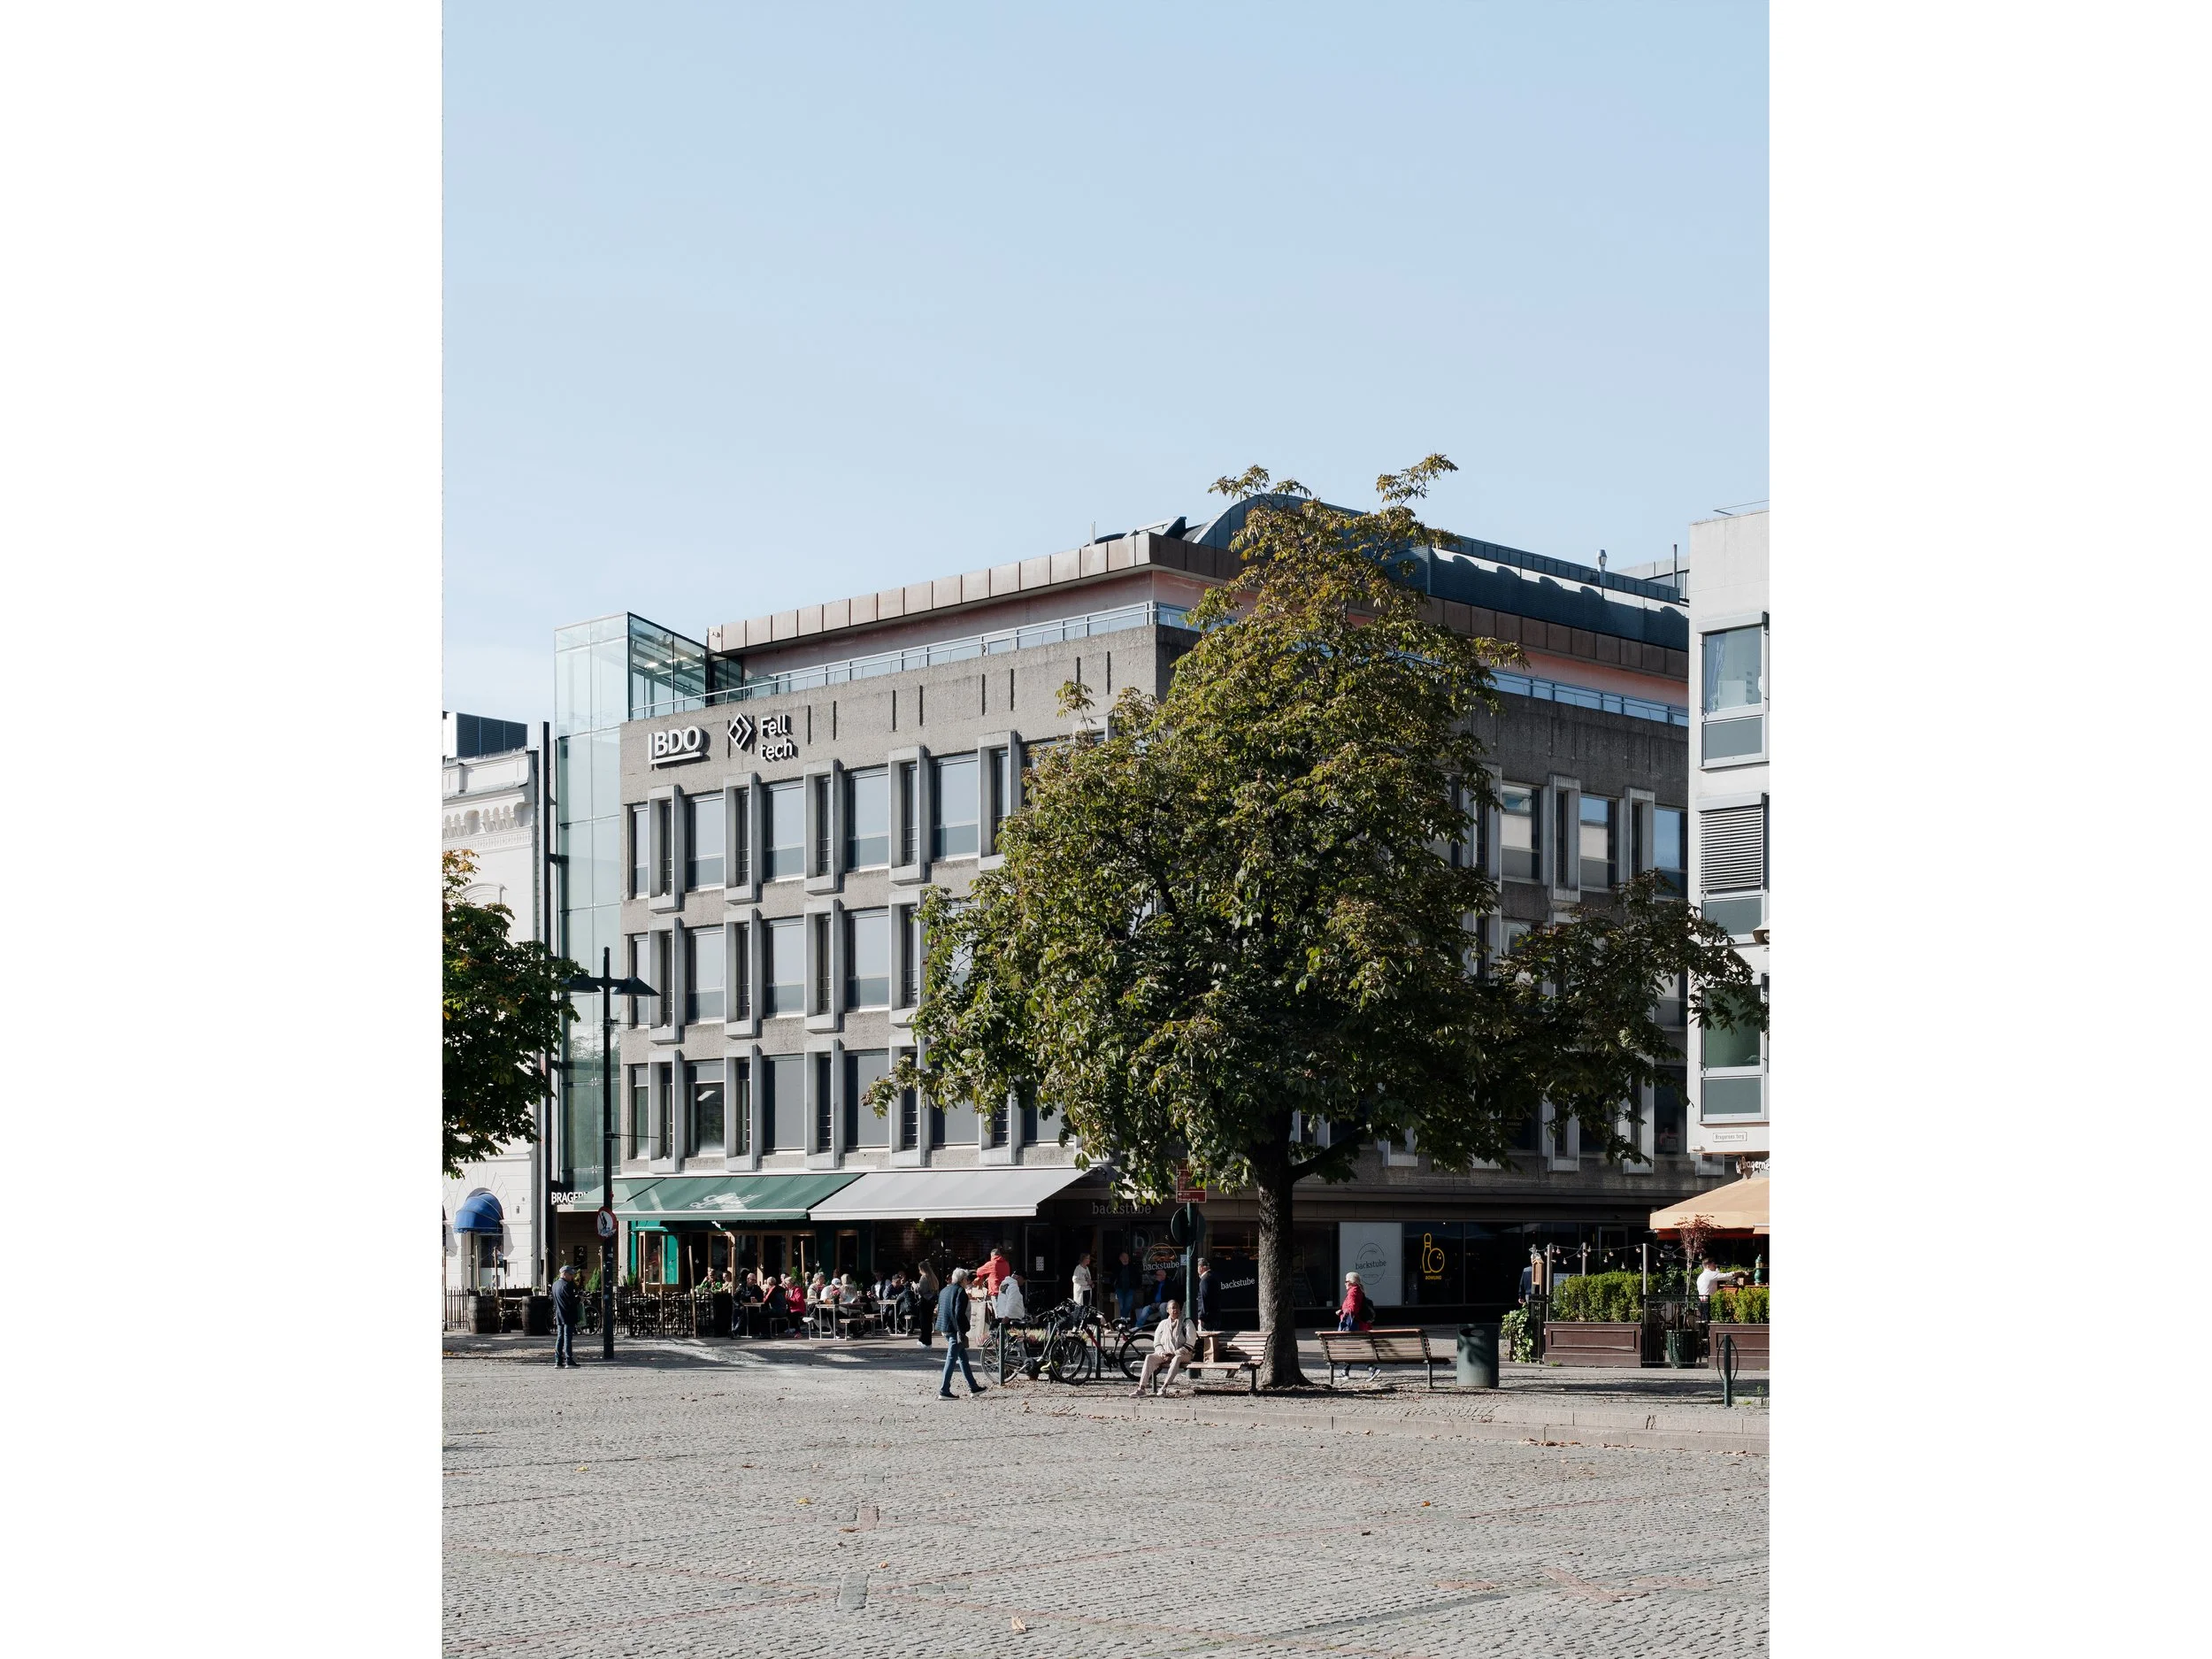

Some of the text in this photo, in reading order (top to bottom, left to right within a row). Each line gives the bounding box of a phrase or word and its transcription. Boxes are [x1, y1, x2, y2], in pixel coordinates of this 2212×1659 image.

[760, 714, 788, 737] Fell
[655, 726, 702, 757] BDO
[759, 738, 794, 760] tech
[1142, 1260, 1180, 1271] backstube
[1355, 1259, 1387, 1270] backstube
[1221, 1277, 1256, 1290] backstube
